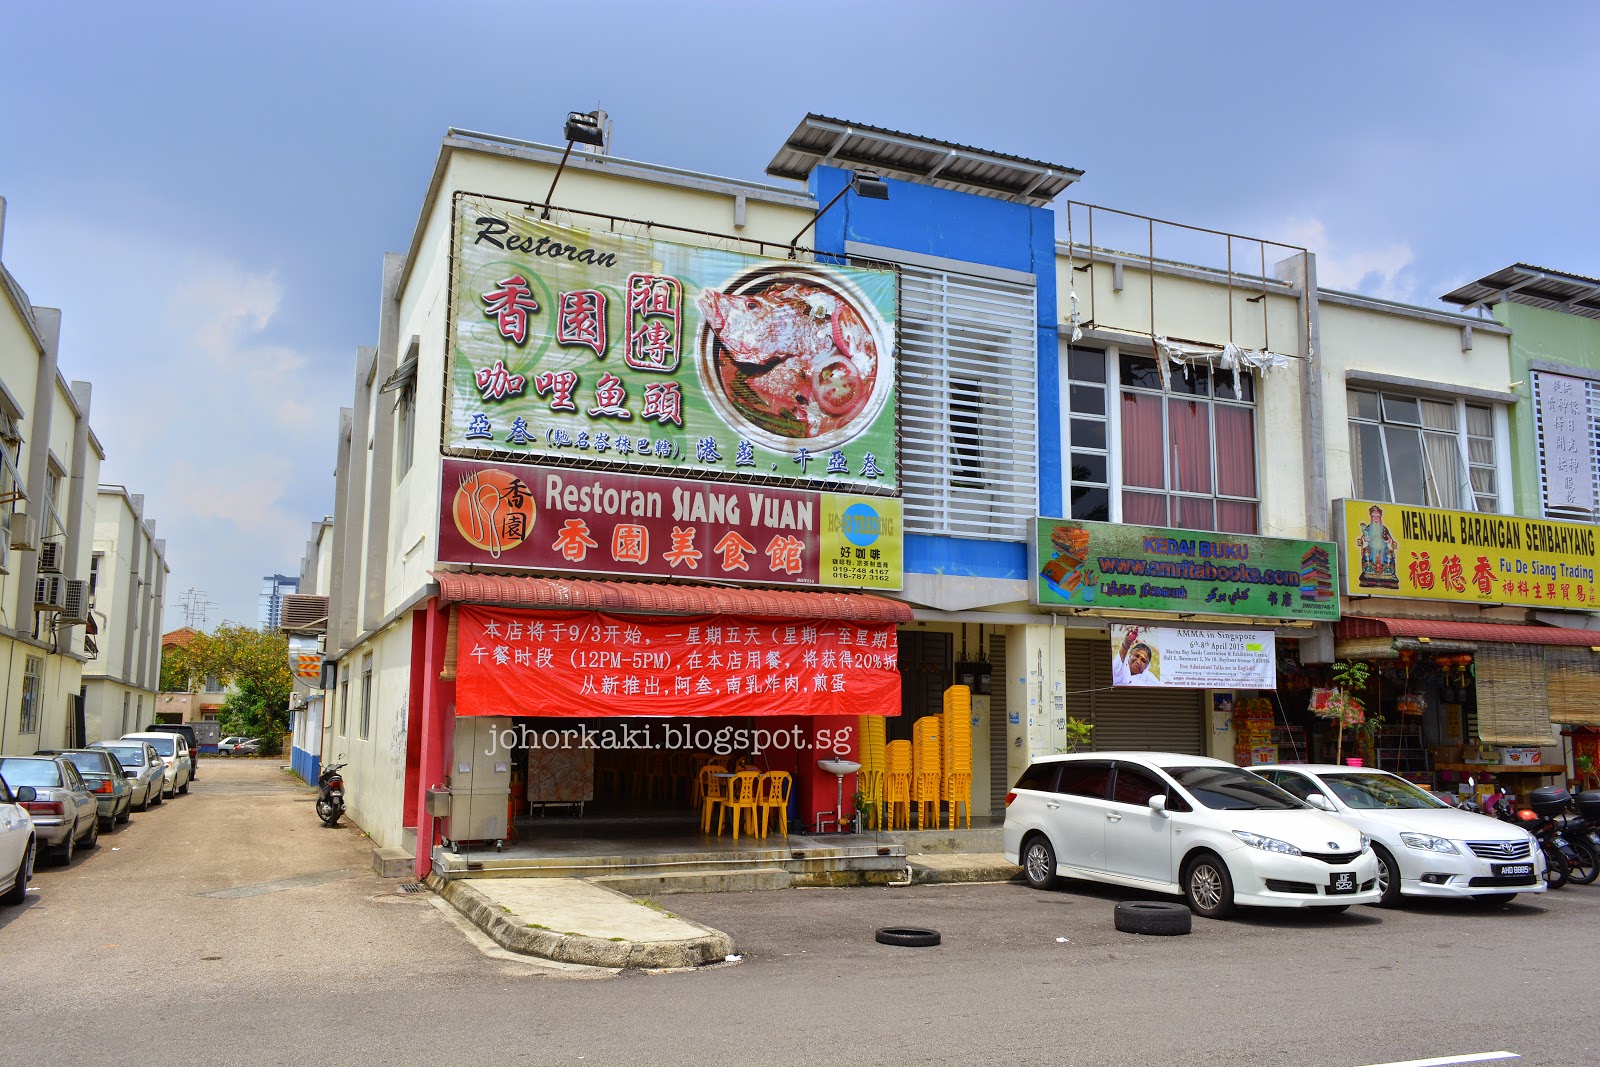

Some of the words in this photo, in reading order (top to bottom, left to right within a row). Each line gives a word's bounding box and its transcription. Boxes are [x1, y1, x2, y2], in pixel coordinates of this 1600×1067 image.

[474, 216, 618, 269] Restoran
[482, 274, 608, 357] 香園
[474, 359, 684, 426] 咖哩魚頭
[499, 478, 533, 542] 香園
[545, 474, 662, 519] Restoran
[671, 485, 741, 523] SIANG
[749, 491, 813, 531] YUAN
[552, 517, 806, 576] 香園美食館
[1142, 535, 1196, 557] KEDAI
[1199, 540, 1249, 560] BUKU
[1401, 510, 1456, 545] MENJUAL
[1460, 516, 1521, 550] BARANGAN
[1525, 522, 1595, 557] SEMBAHYANG
[840, 546, 881, 561] 好咖啡
[832, 566, 867, 574] 019-748
[832, 572, 867, 580] 016-787
[1097, 556, 1301, 587] www.amritabooks.com
[1408, 551, 1498, 595] 福德香
[1500, 557, 1512, 573] Fu
[1516, 559, 1528, 574] De
[1532, 560, 1557, 580] Siang
[1560, 562, 1594, 584] Trading
[1177, 629, 1205, 638] AMMA
[1217, 631, 1256, 641] Singapore
[1211, 642, 1227, 651] April
[1335, 880, 1353, 890] 5252
